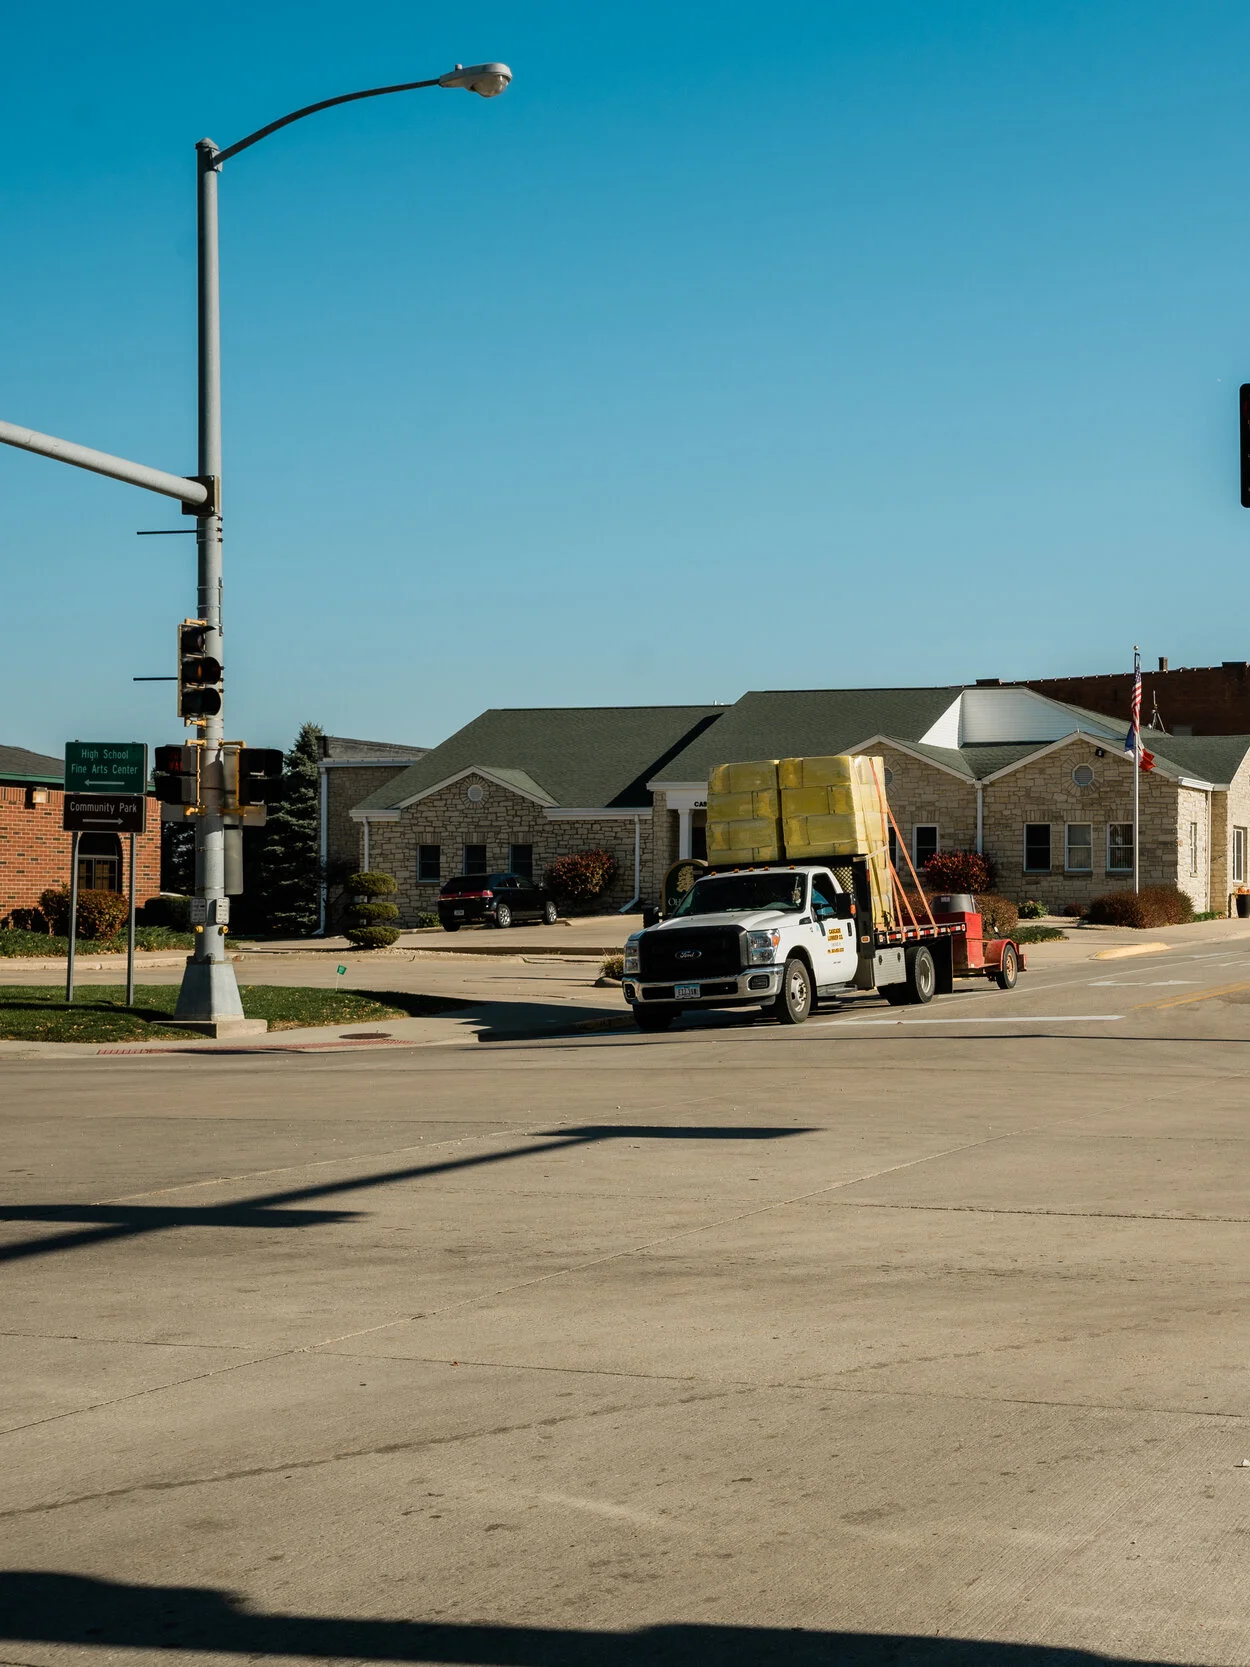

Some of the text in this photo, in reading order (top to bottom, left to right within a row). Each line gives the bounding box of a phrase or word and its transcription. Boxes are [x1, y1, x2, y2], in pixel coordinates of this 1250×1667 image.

[82, 749, 128, 760] High School
[72, 764, 138, 774] Fine Arts Center
[70, 802, 137, 814] Community Park
